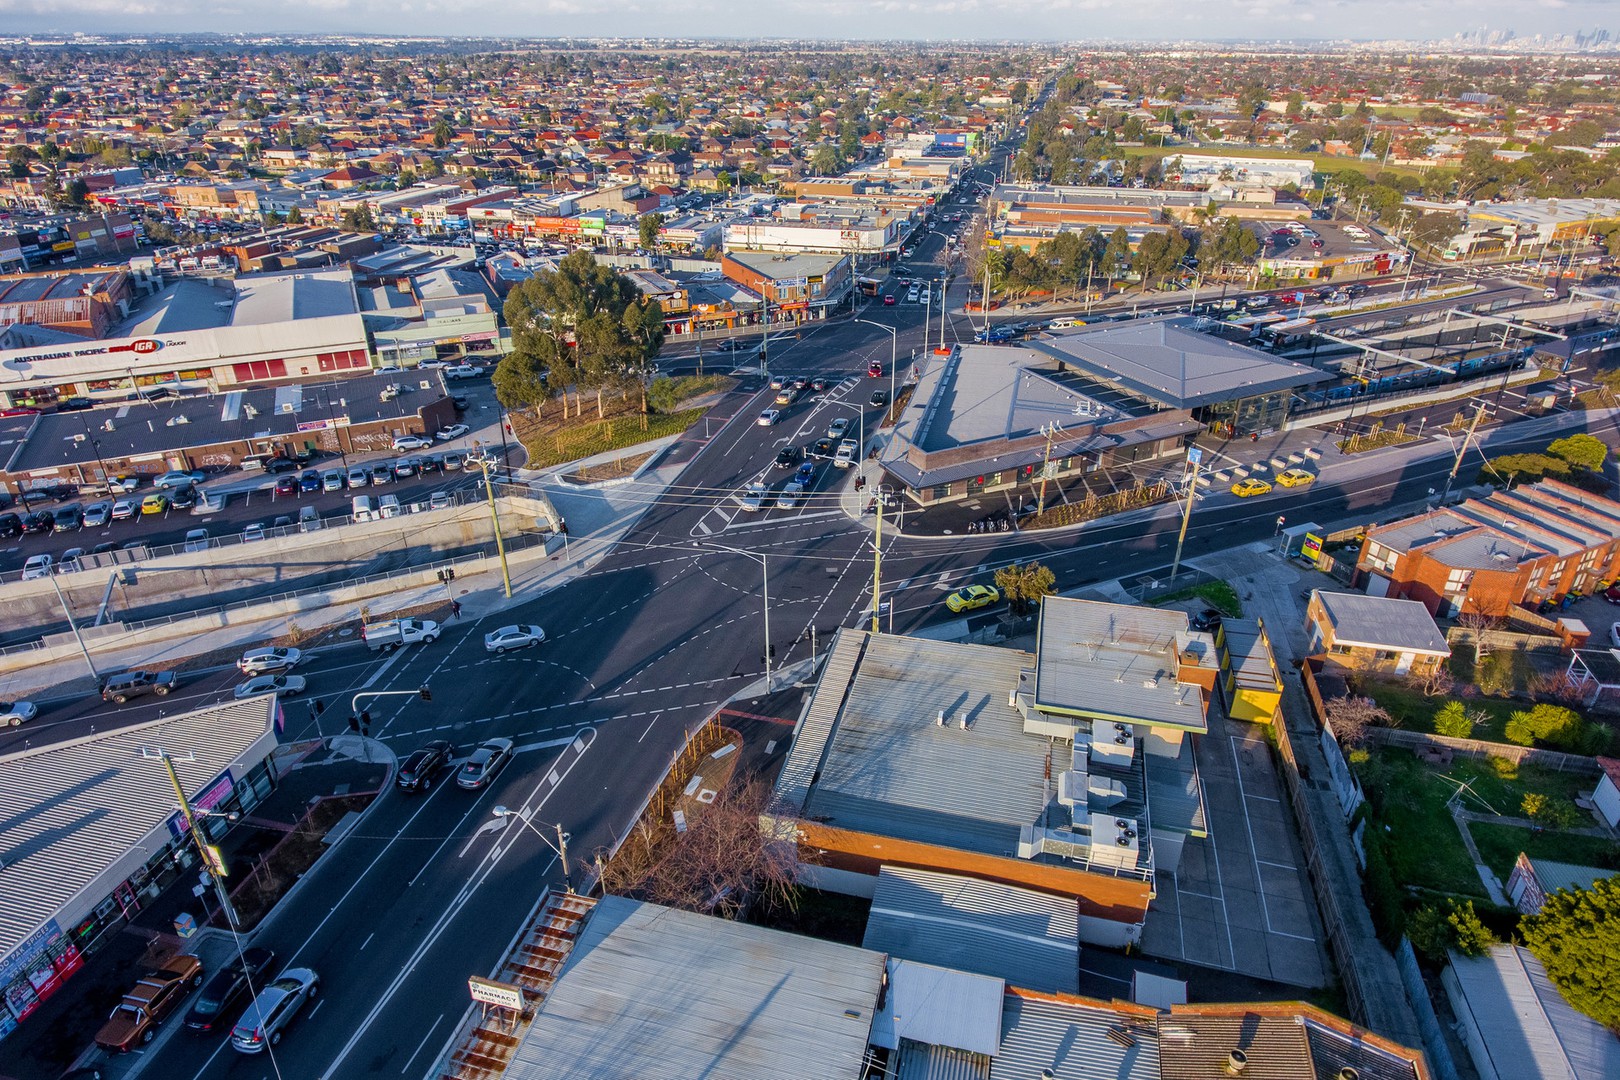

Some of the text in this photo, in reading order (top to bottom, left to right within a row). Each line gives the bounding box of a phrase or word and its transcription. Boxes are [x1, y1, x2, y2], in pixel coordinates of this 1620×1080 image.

[134, 342, 153, 351] IGA
[13, 351, 71, 364] AUSTRALIAN
[74, 347, 107, 357] PACIFIC
[11, 947, 25, 963] PAK
[26, 924, 50, 947] SPICES
[472, 988, 517, 1002] PHARMACY
